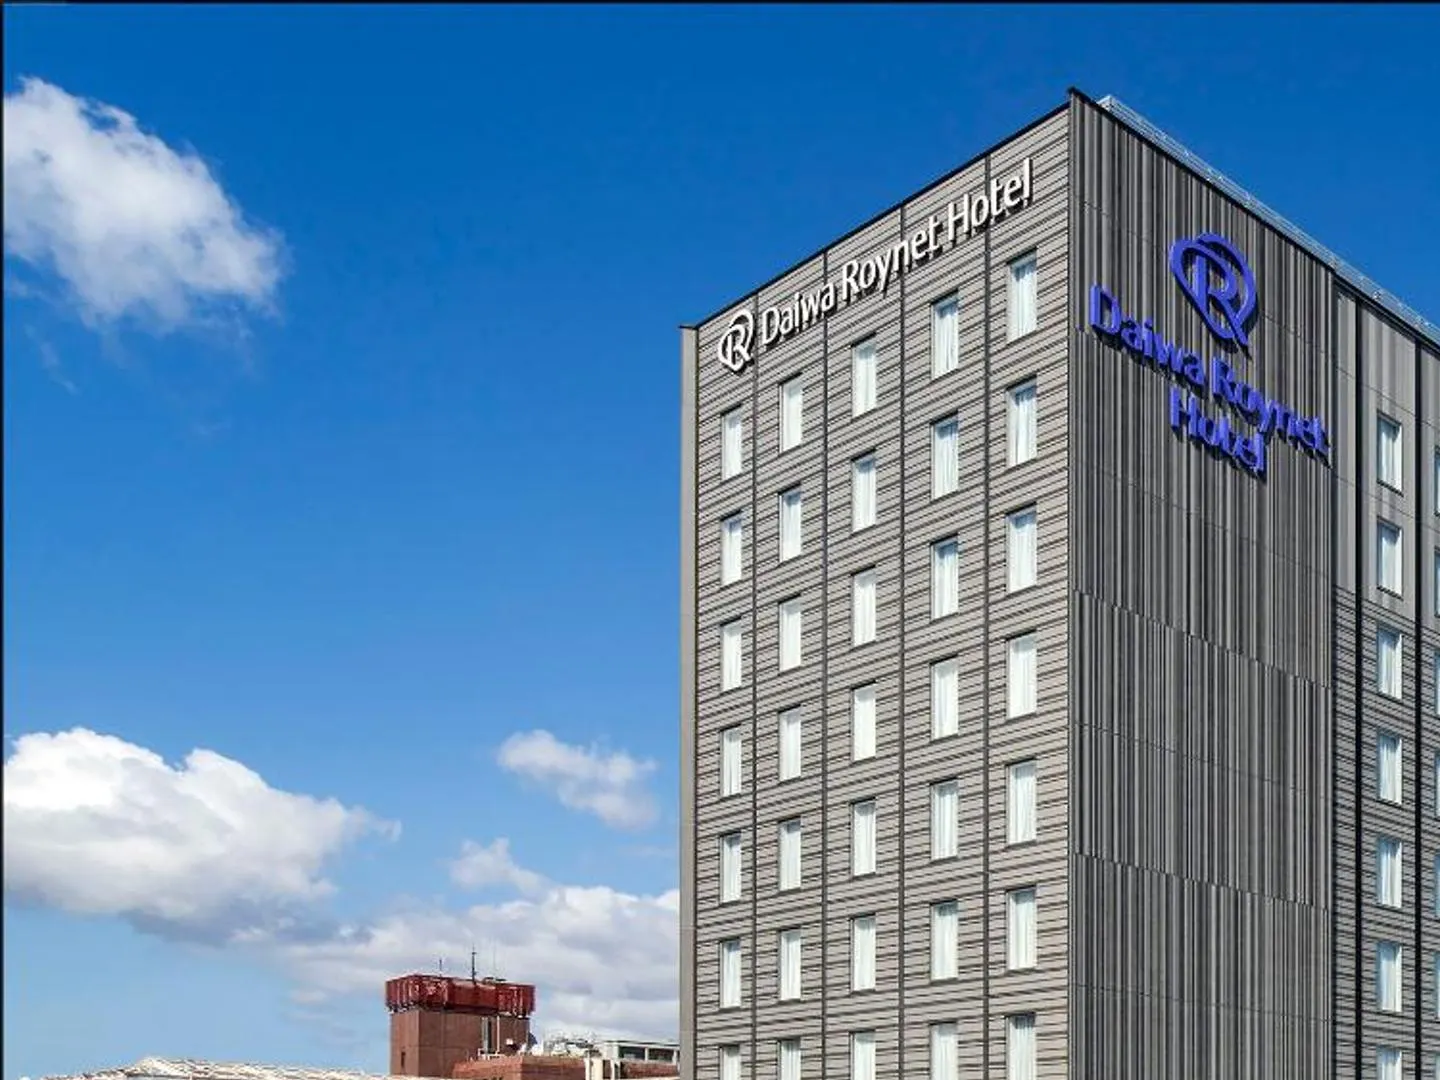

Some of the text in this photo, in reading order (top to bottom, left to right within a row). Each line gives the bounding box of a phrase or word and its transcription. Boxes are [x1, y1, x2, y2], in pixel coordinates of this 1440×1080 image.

[761, 281, 834, 345] Daiwa
[842, 215, 941, 300] Roynet
[948, 157, 1032, 241] Hotel
[1089, 284, 1331, 456] Daiwa Roynet
[1170, 386, 1266, 472] Hotel
